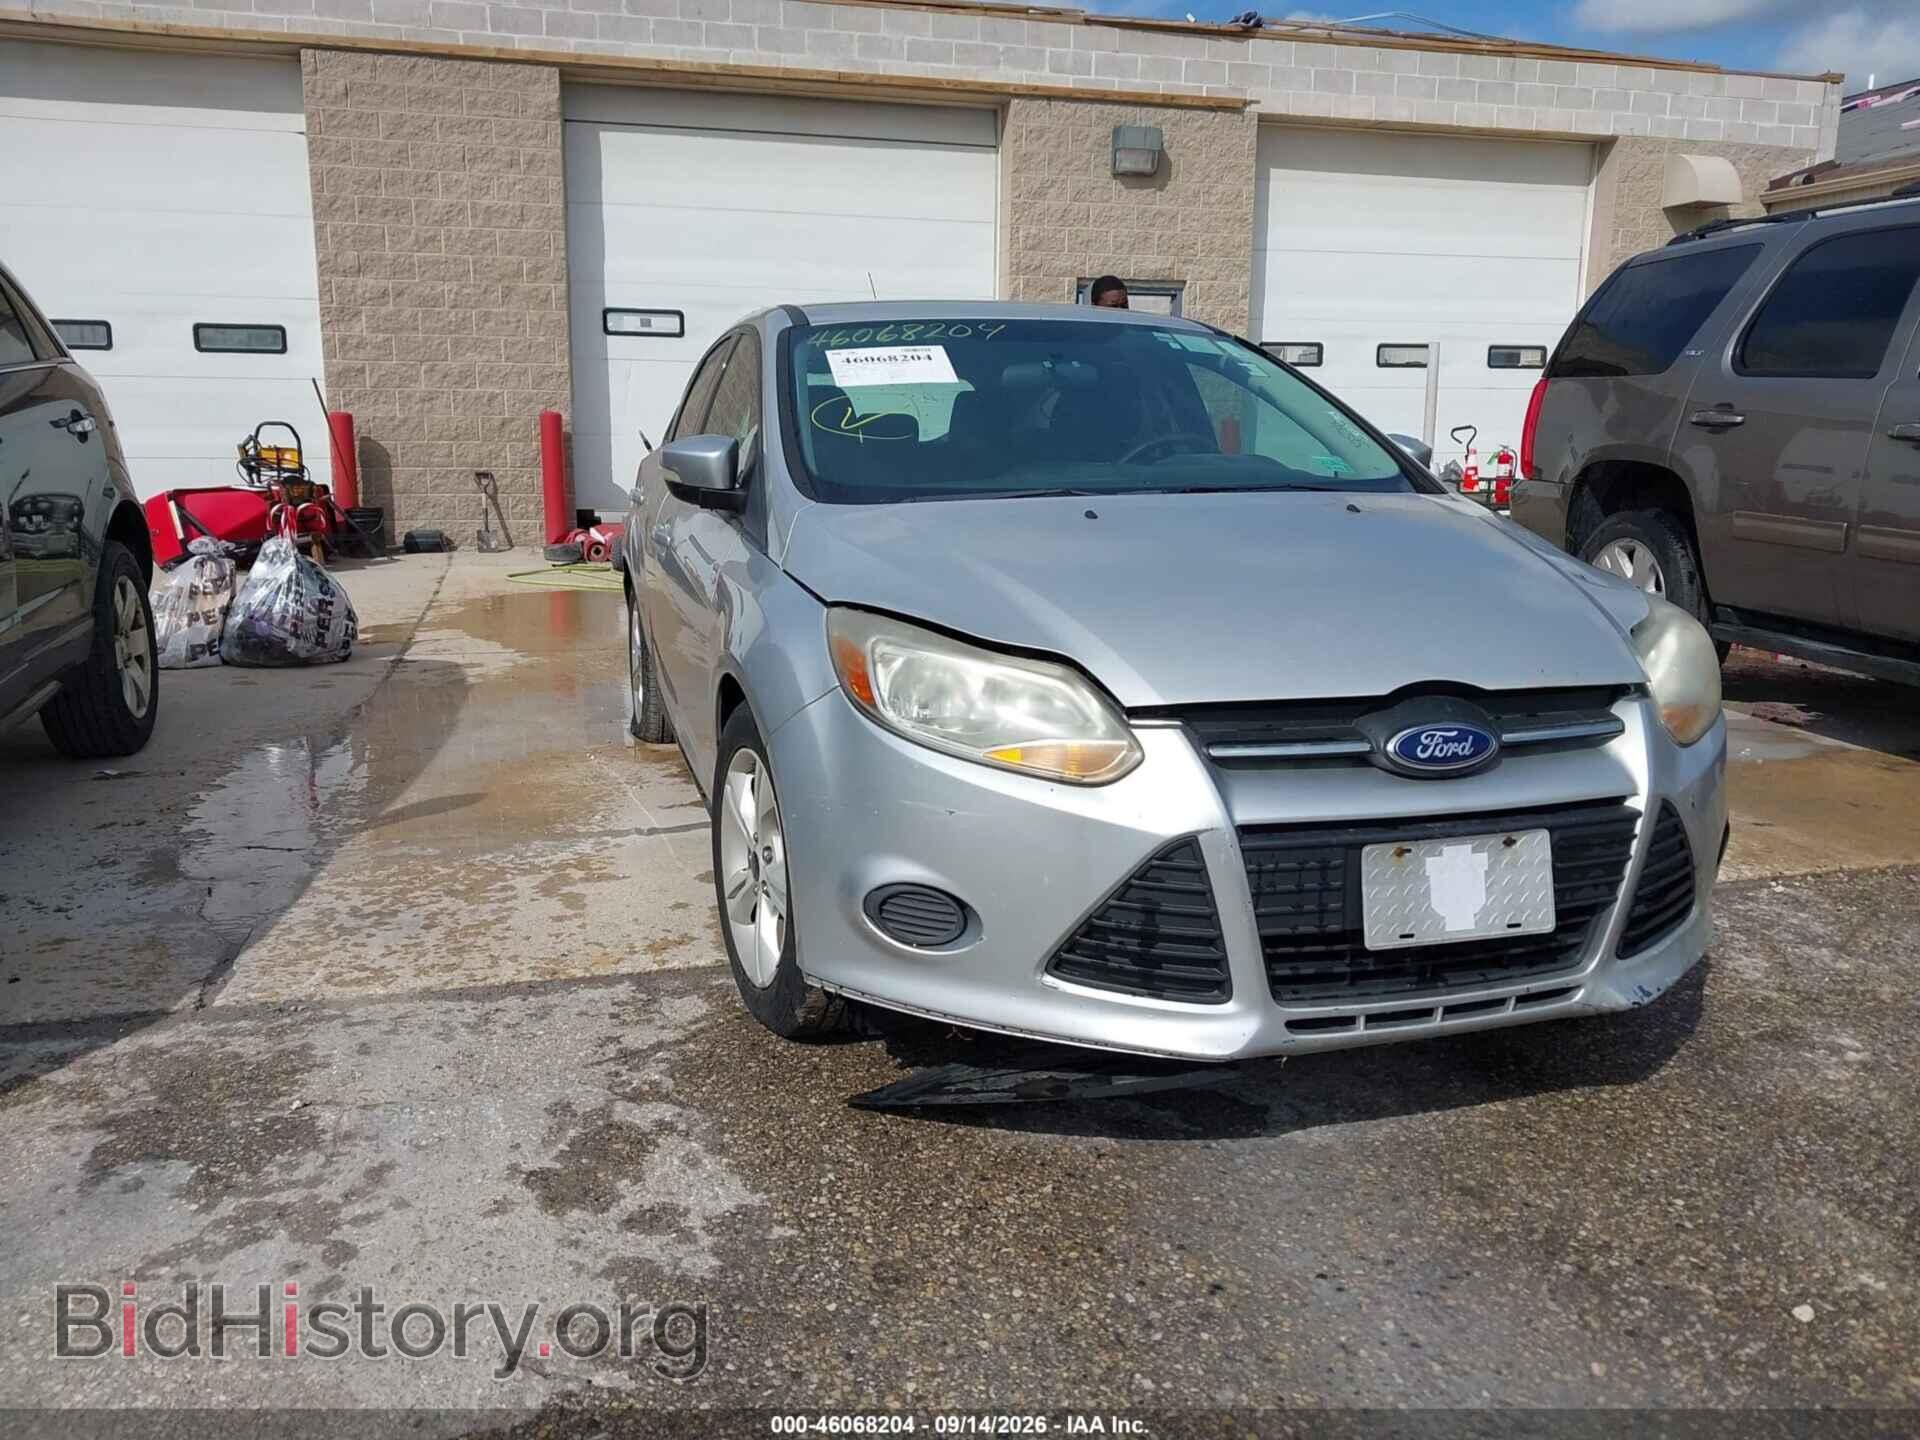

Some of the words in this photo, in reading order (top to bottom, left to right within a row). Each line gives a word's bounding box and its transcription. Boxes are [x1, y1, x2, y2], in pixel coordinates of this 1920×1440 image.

[807, 323, 1006, 348] 46068204
[840, 354, 932, 364] 46068204
[1416, 730, 1474, 759] Ford
